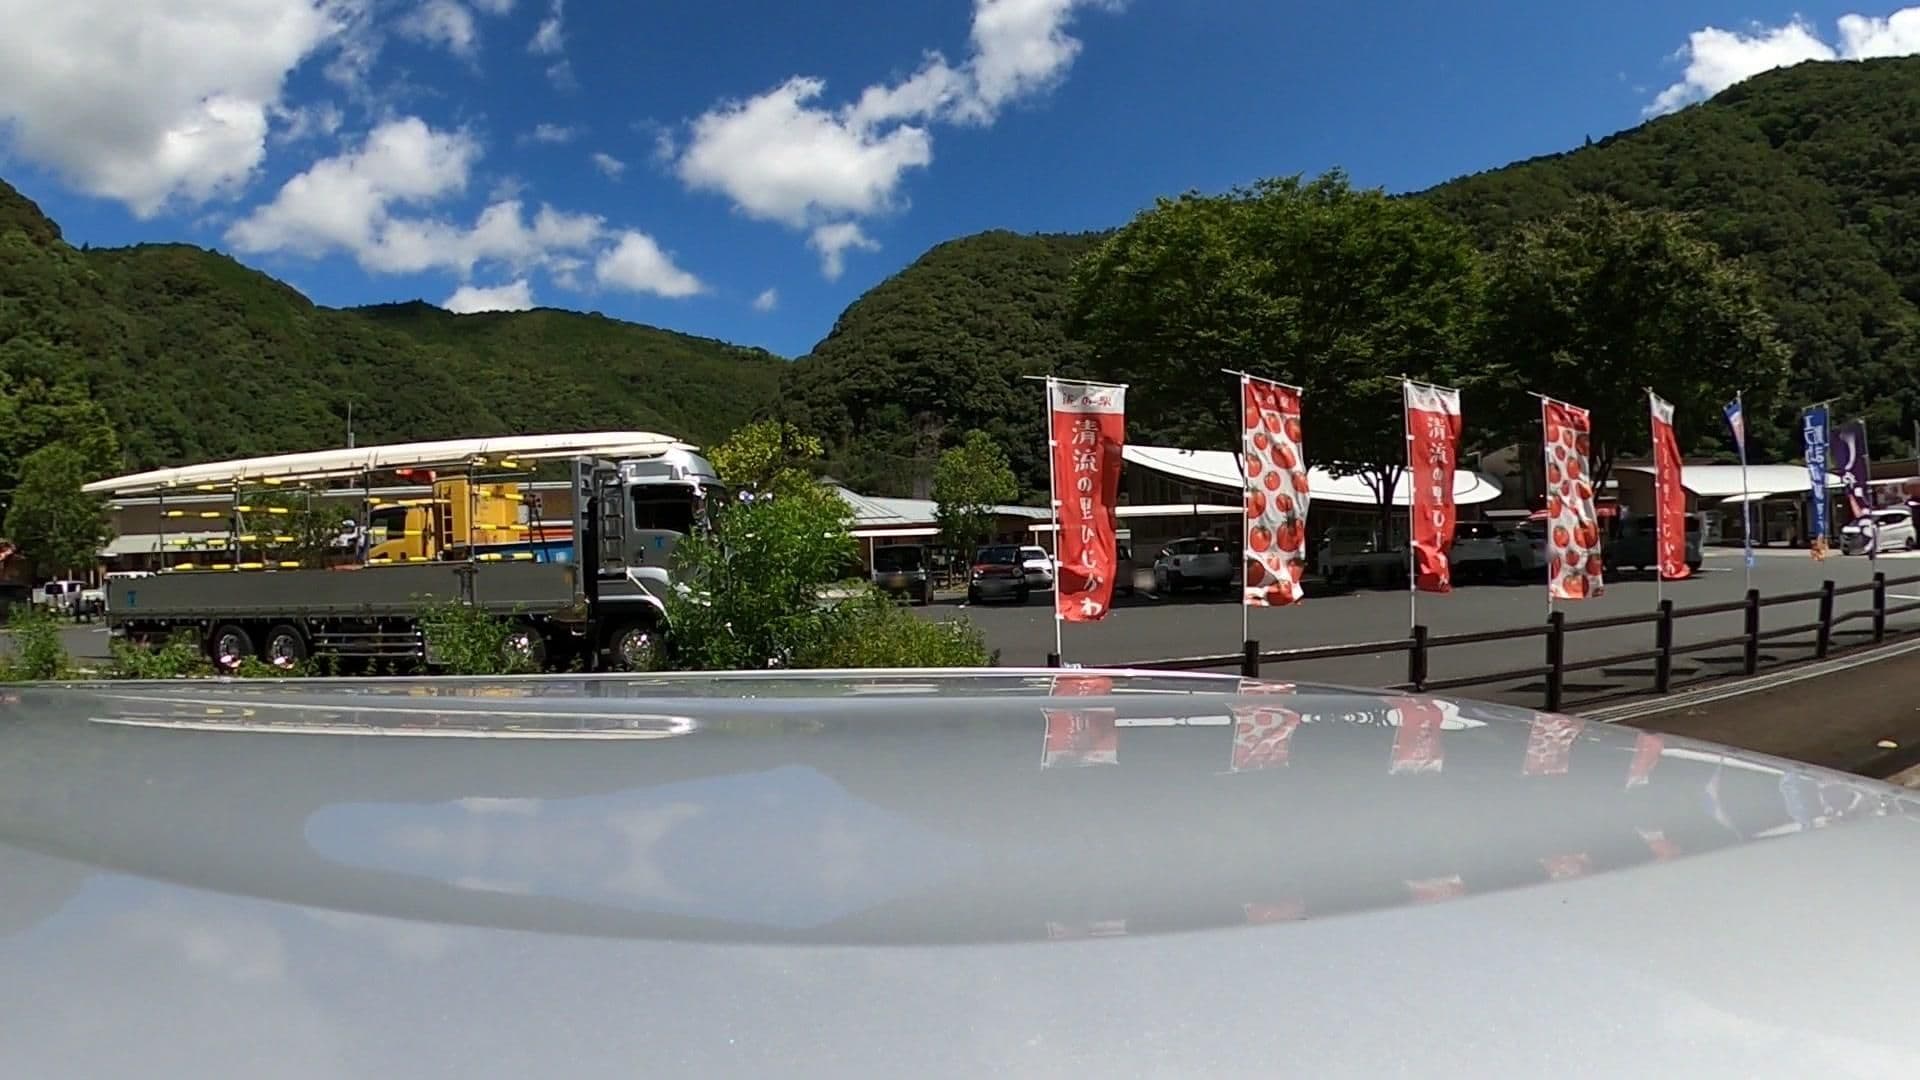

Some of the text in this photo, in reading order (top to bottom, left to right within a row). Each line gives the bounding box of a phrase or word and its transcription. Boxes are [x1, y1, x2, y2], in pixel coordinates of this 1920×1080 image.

[1072, 419, 1103, 616] 清流の里ひじかわ
